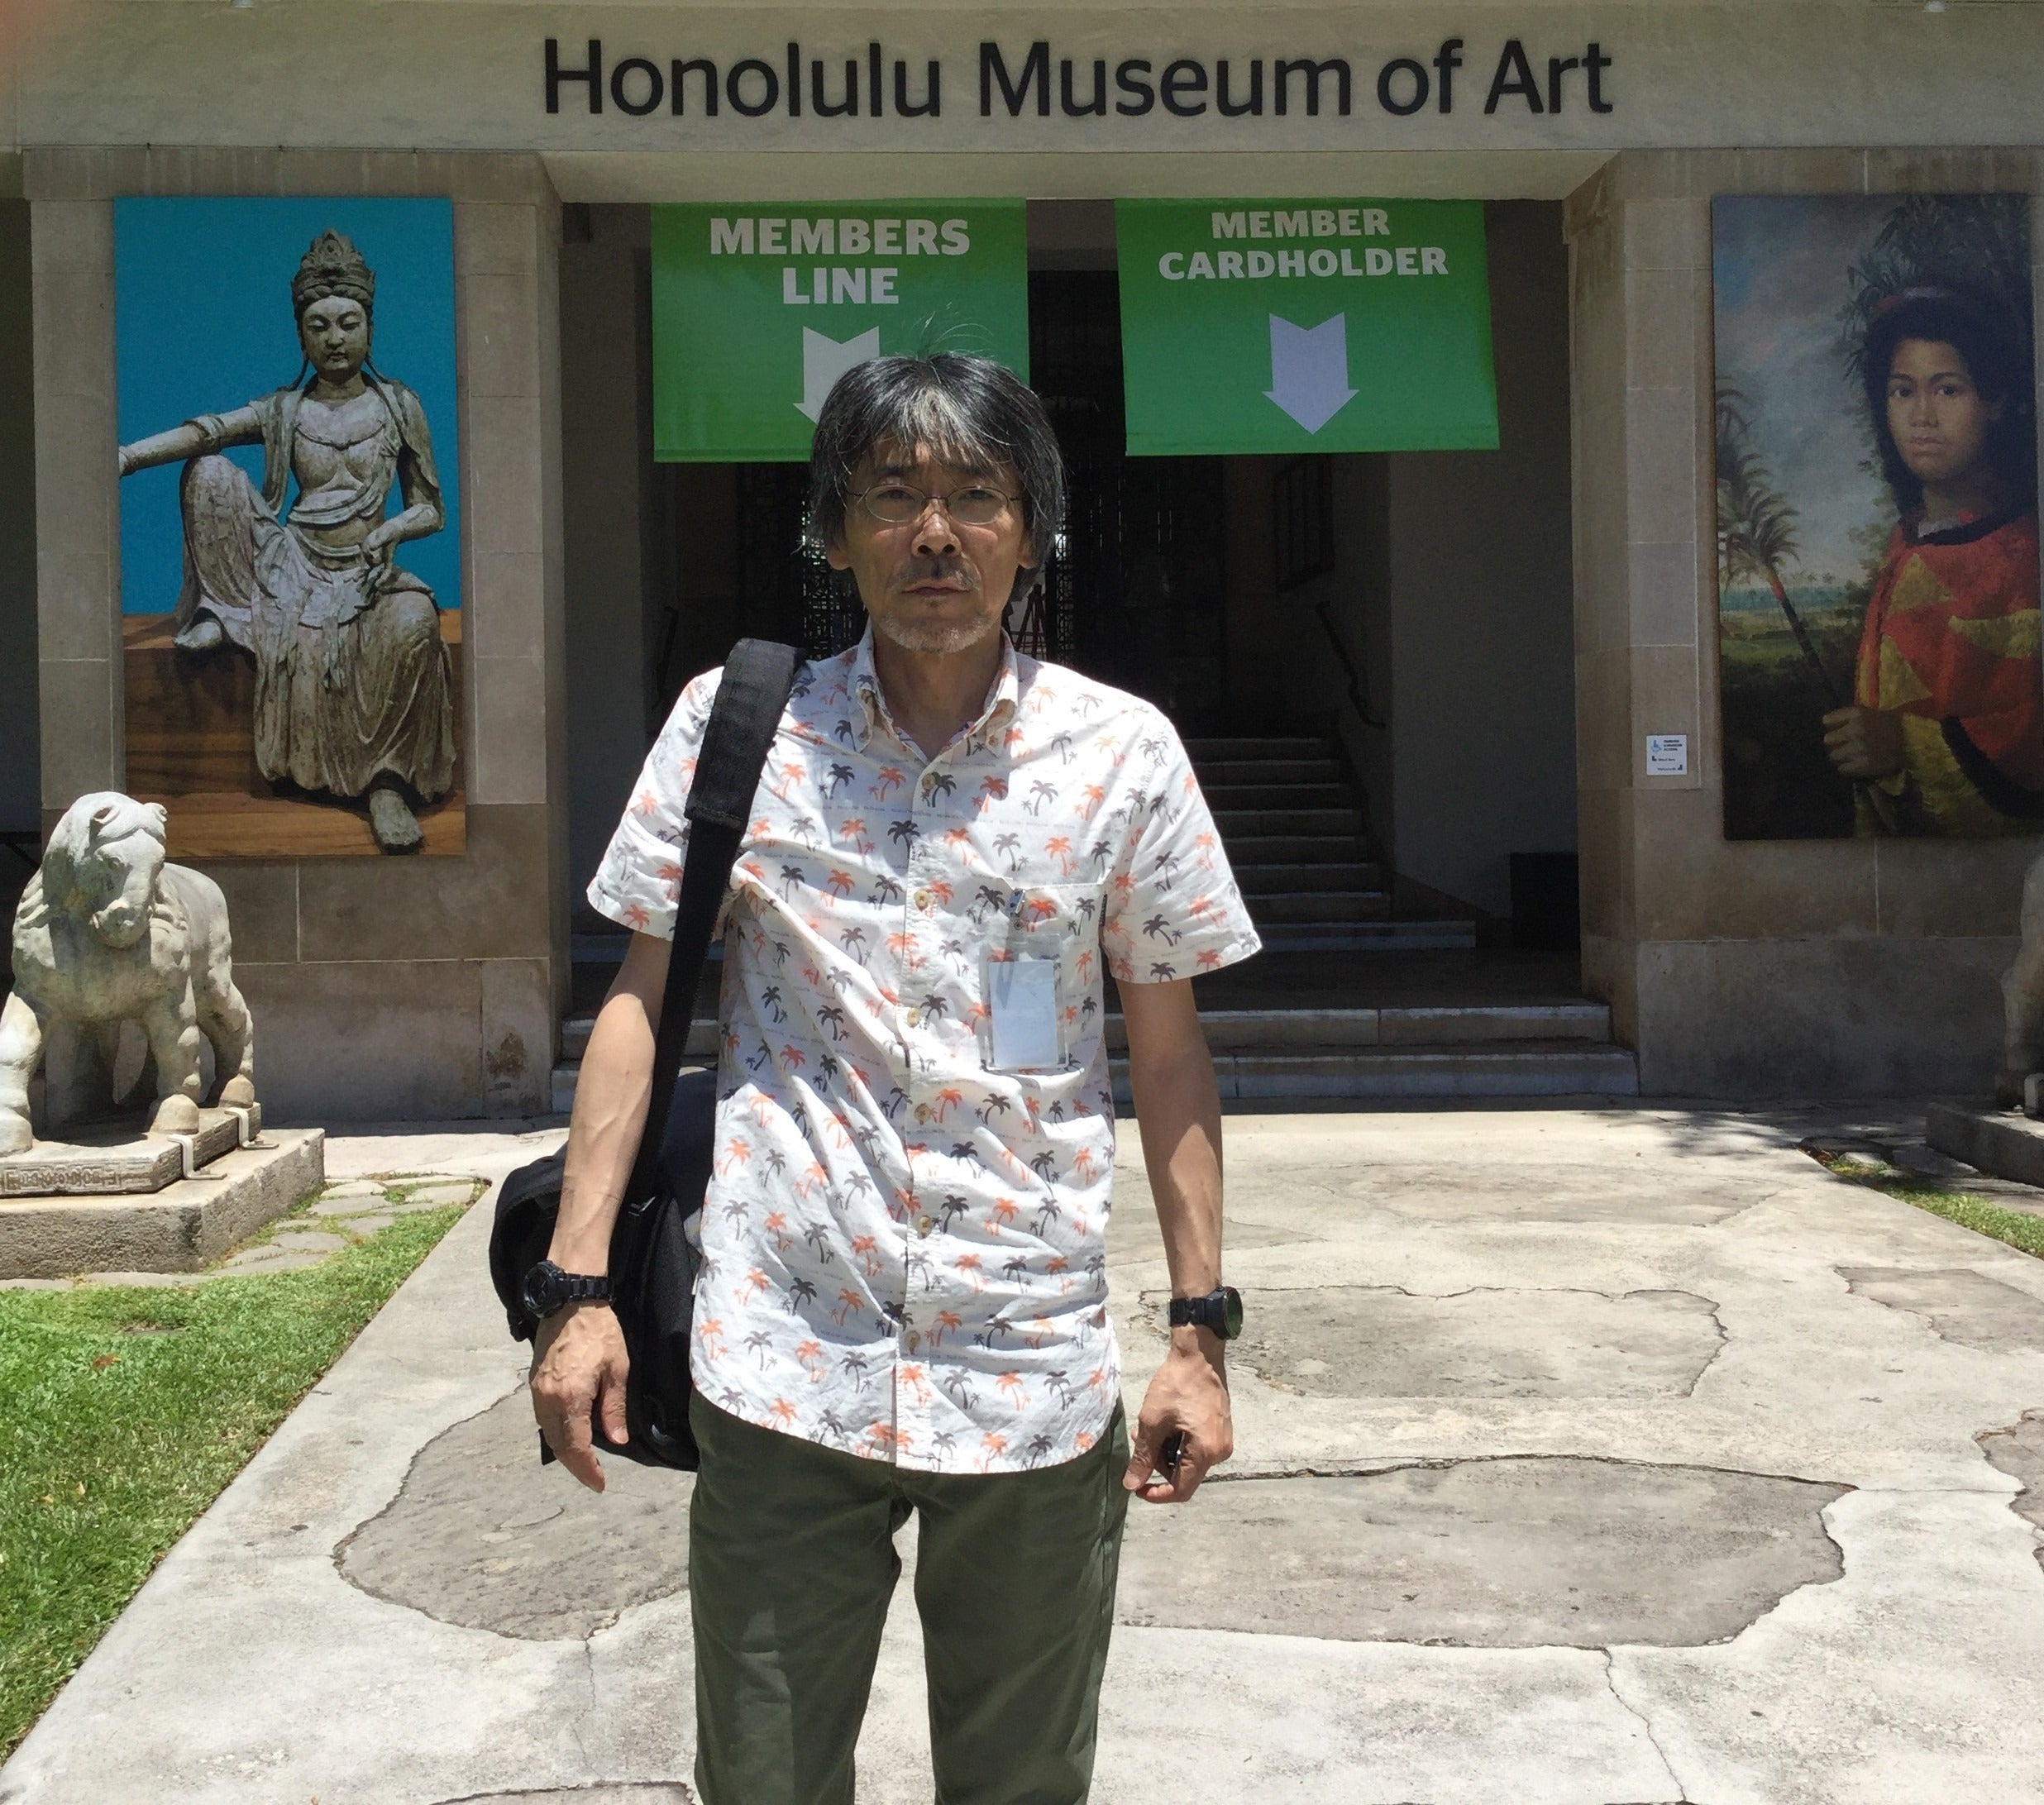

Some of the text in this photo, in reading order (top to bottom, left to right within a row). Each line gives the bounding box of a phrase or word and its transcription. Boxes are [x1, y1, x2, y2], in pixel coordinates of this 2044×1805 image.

[544, 36, 1614, 117] Honolulu Museum of Art
[710, 218, 970, 255] MEMBERS
[1211, 208, 1390, 240] MEMBER
[1158, 246, 1449, 281] CARDHOLDER
[782, 267, 900, 305] LINE
